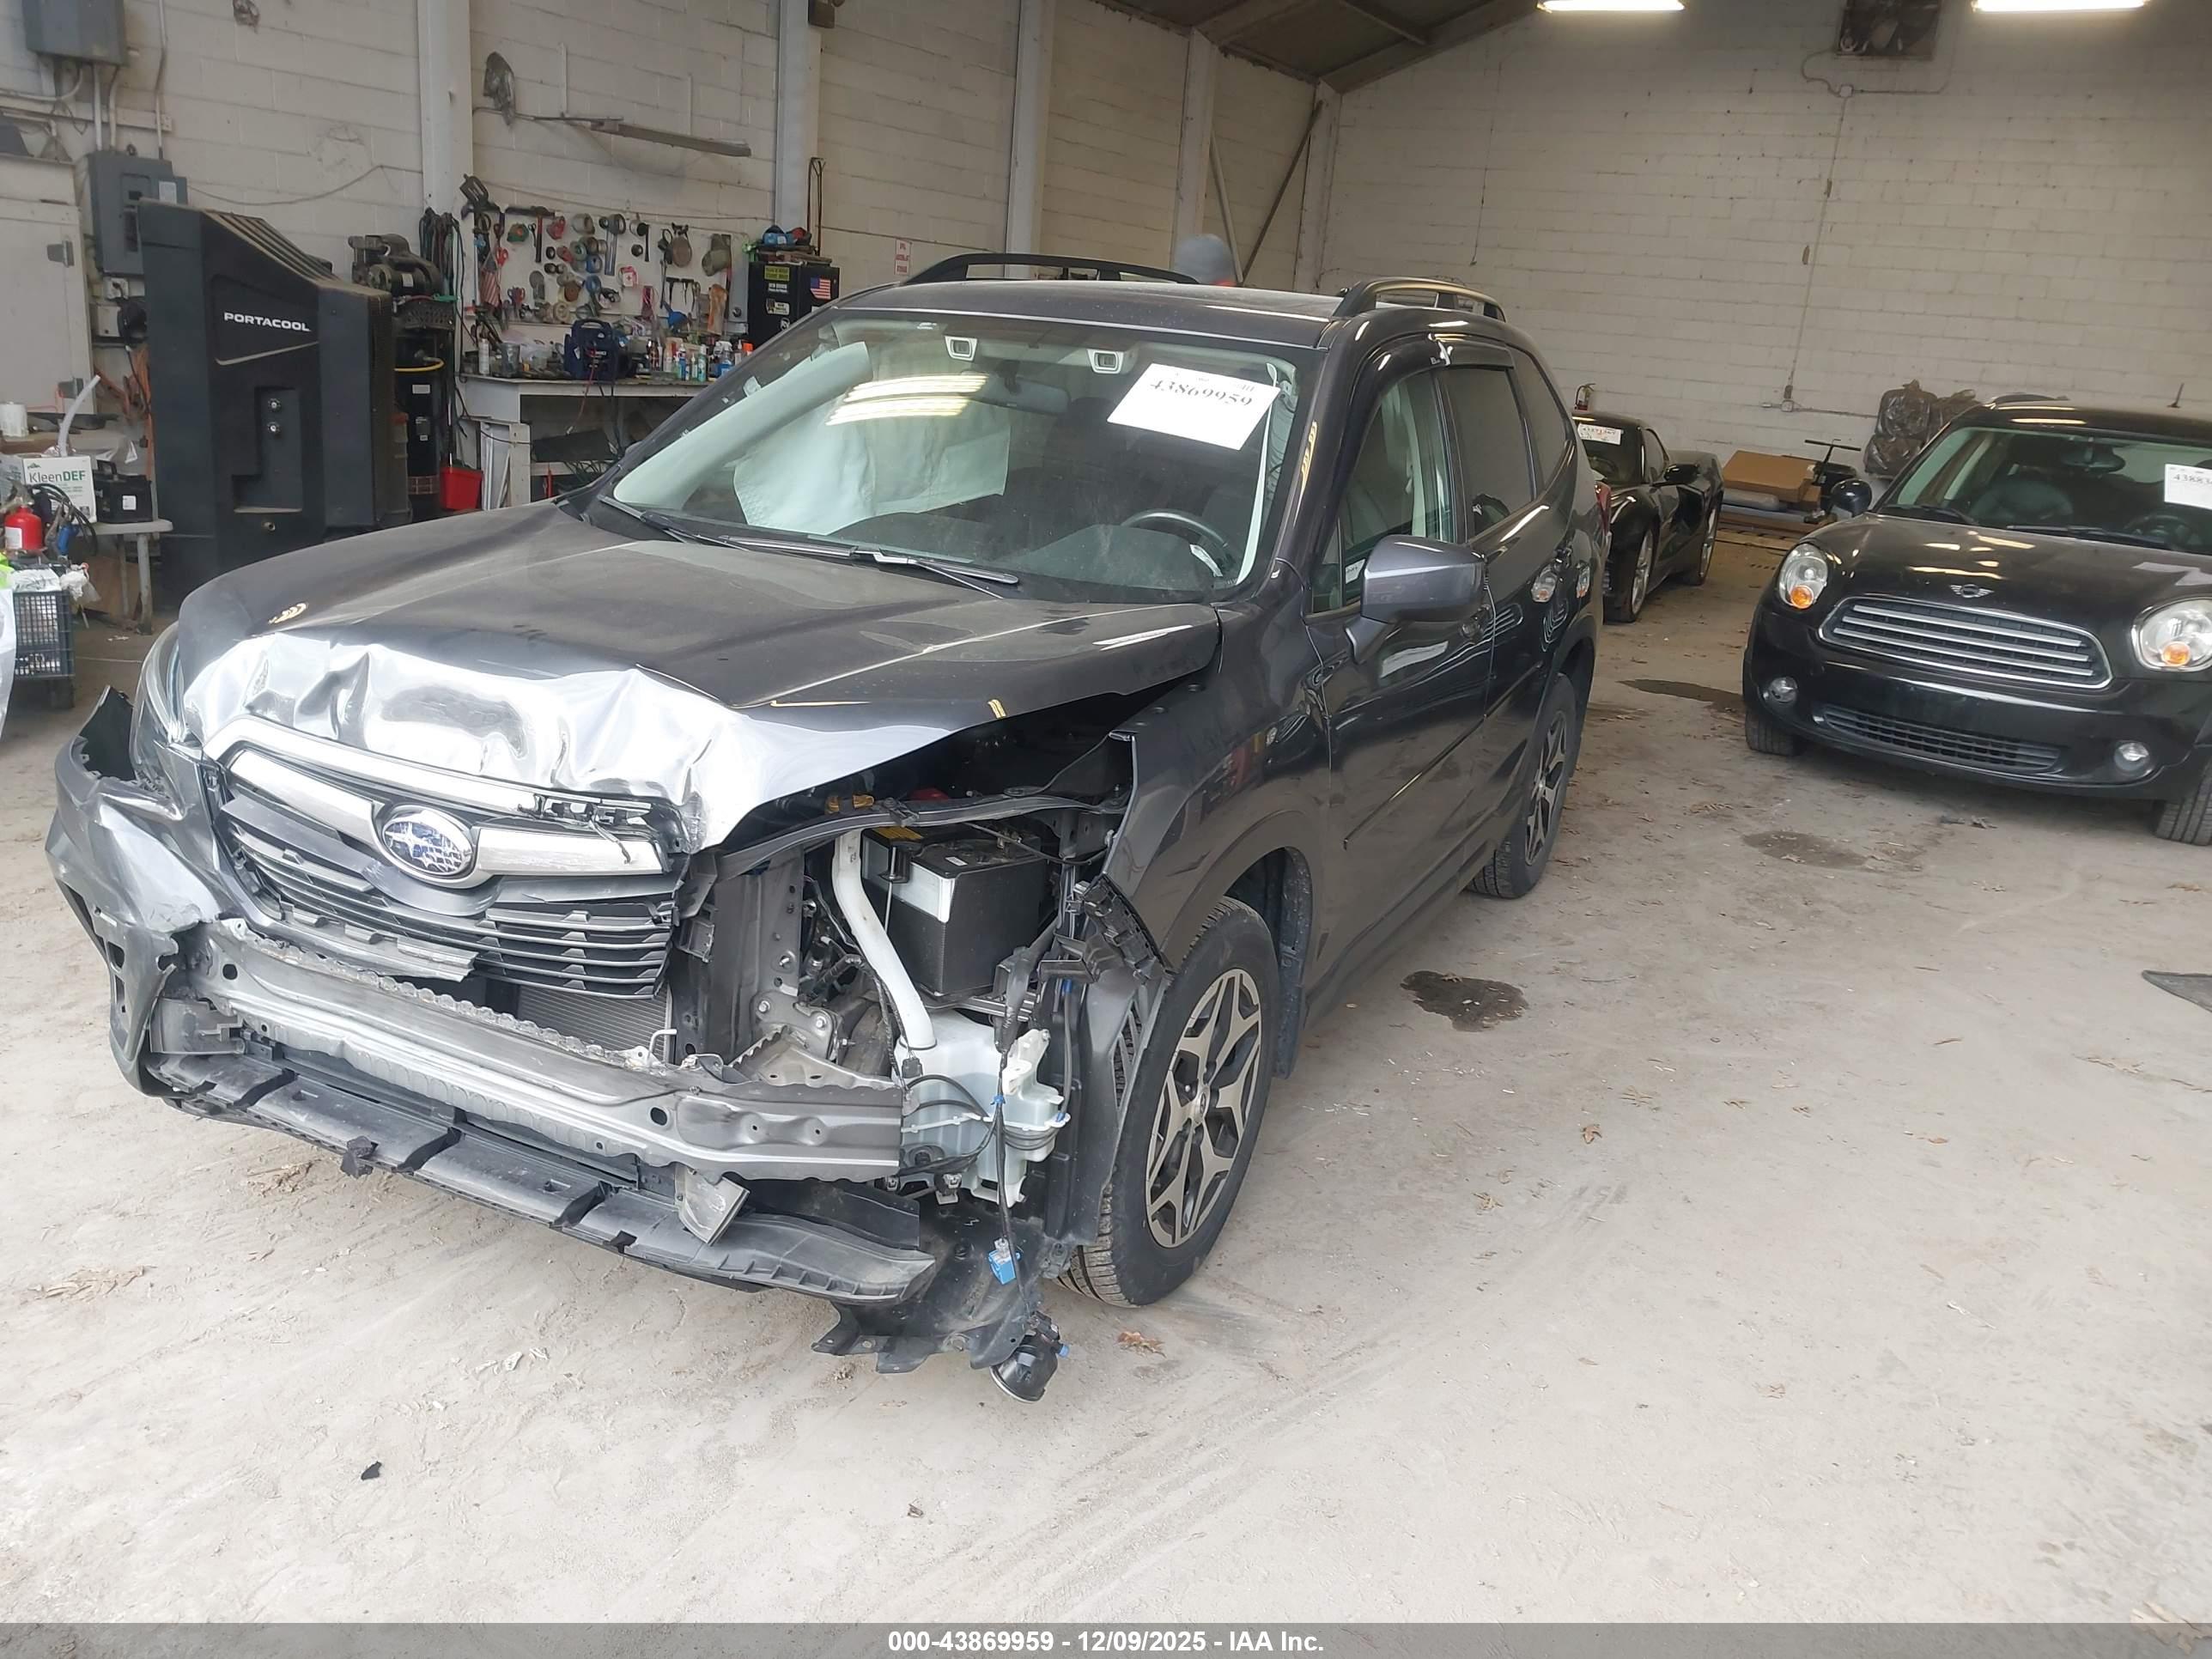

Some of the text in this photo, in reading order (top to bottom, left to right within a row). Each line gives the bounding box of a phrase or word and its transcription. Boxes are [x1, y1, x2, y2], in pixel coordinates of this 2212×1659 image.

[223, 312, 312, 332] PORTACOOL
[1151, 379, 1253, 407] 43869959
[28, 470, 86, 483] KleenDEF
